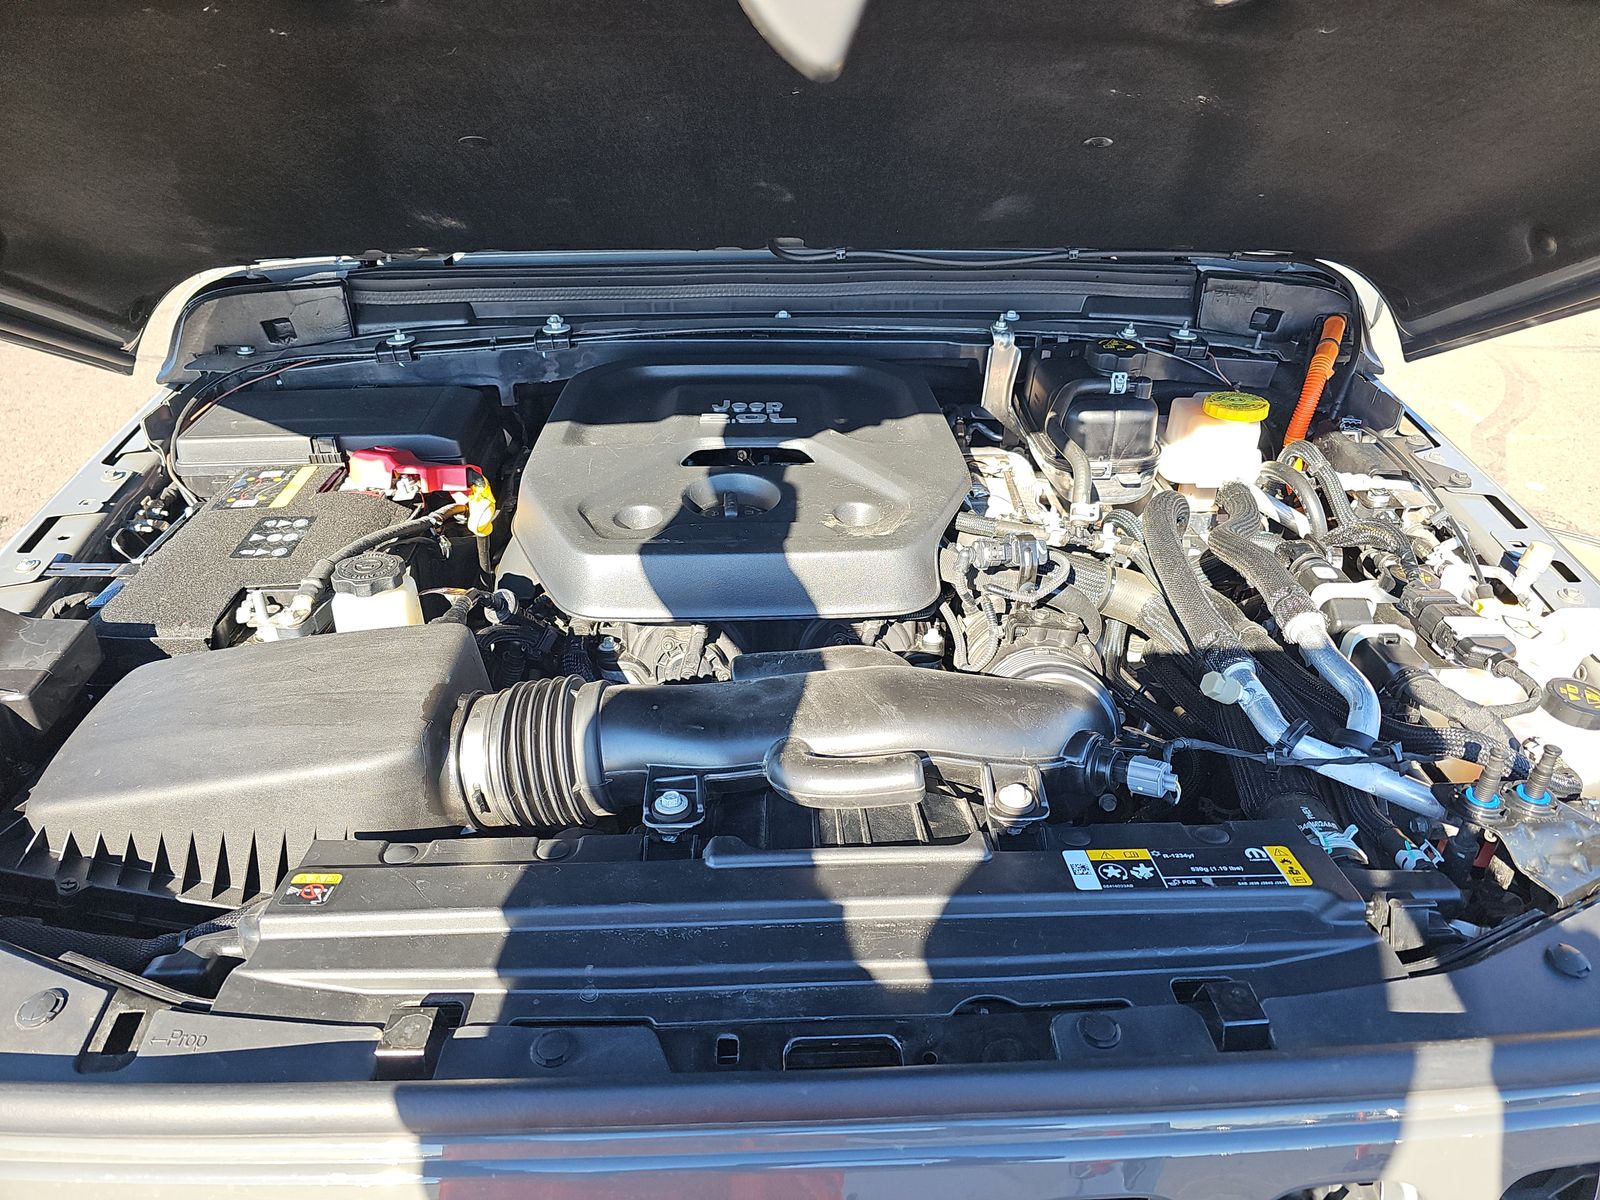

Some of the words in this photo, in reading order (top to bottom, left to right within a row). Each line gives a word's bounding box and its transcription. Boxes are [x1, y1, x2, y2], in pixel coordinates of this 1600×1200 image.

[711, 399, 783, 413] Jeep
[699, 413, 797, 424] 2.0L
[167, 1028, 208, 1052] Prop
